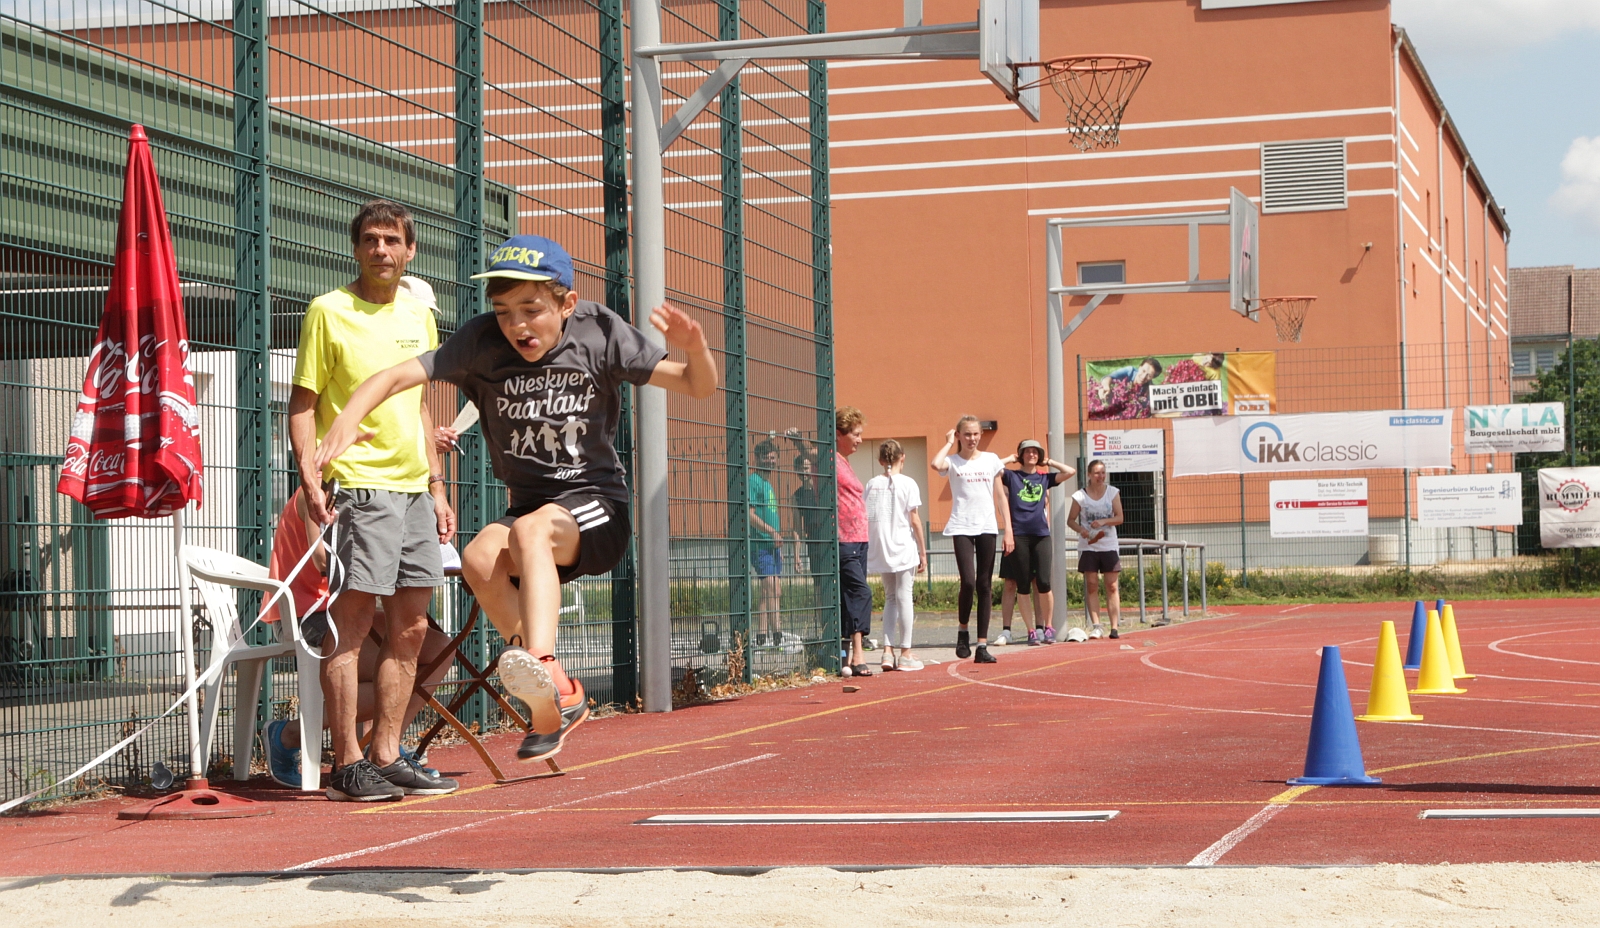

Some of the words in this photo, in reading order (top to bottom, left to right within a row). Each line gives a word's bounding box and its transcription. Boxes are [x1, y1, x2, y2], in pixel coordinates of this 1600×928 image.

[490, 246, 544, 267] STICKY
[504, 368, 588, 395] Nieskyer
[1152, 385, 1184, 395] Mach's
[1186, 383, 1218, 393] einfach
[496, 384, 596, 420] Paarlauf
[1153, 396, 1179, 410] mit
[1183, 392, 1218, 408] OBI!
[1470, 428, 1538, 438] Baugesellschaft
[1302, 440, 1378, 462] classic
[554, 467, 582, 480] 2017
[1469, 485, 1495, 493] Klupsch
[1275, 499, 1299, 508] GTÜ
